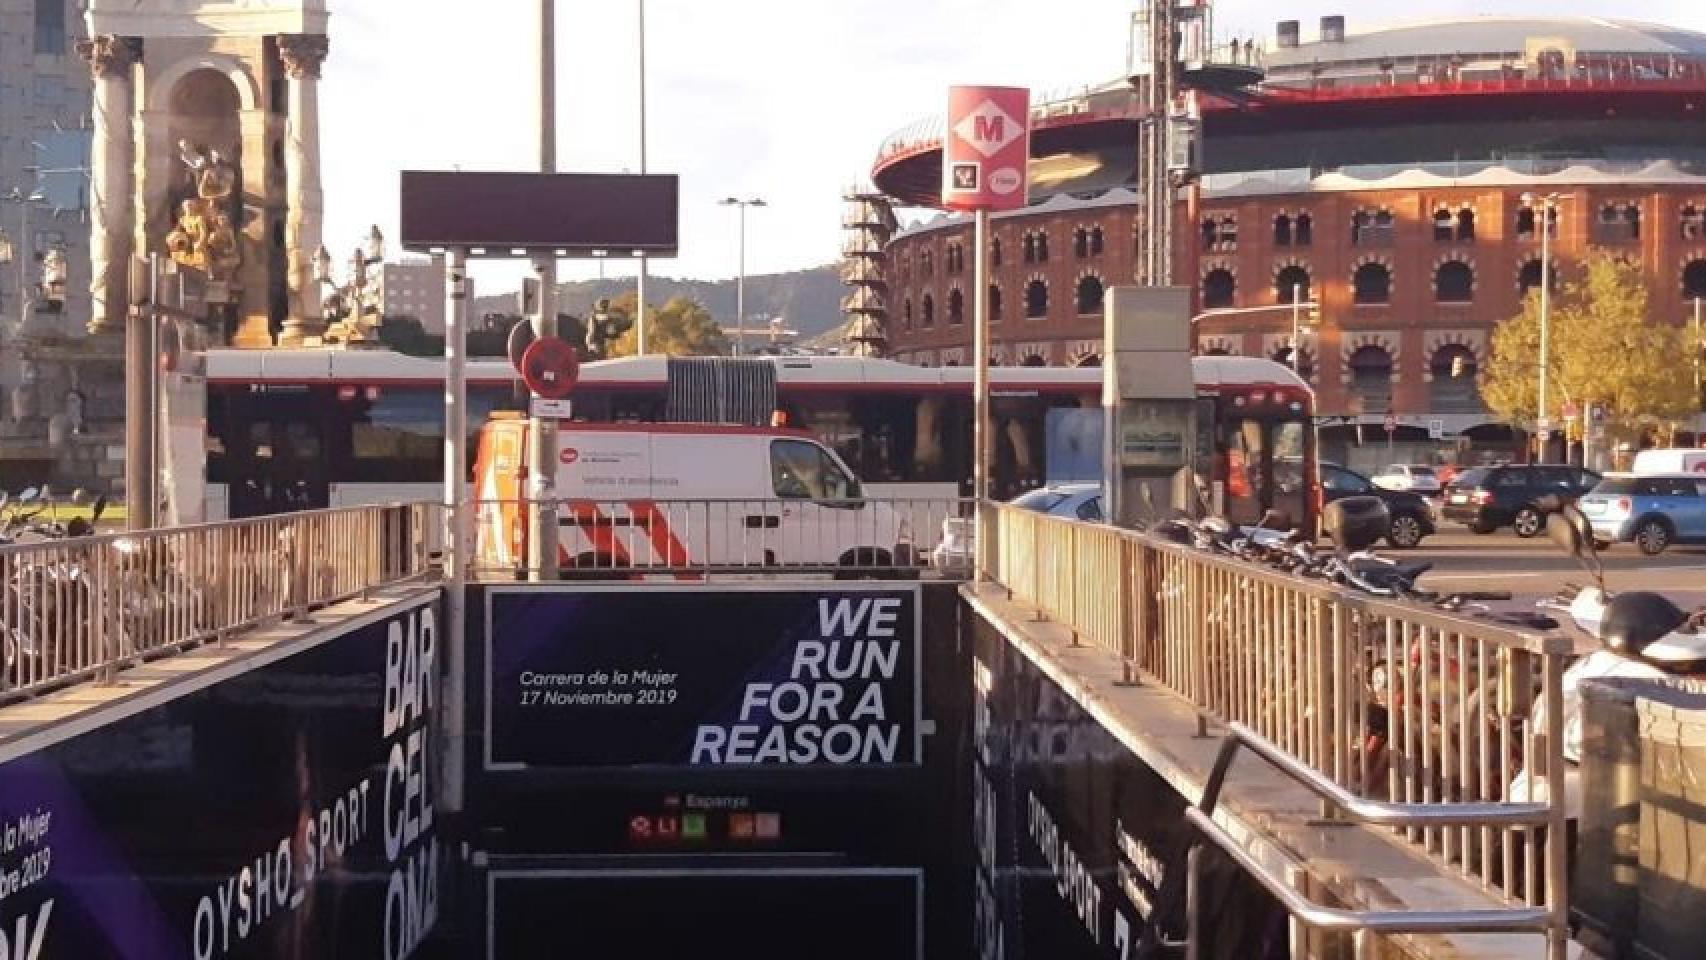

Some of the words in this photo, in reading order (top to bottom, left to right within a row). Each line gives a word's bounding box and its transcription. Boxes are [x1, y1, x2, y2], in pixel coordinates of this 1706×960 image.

[975, 115, 1003, 141] M
[818, 597, 901, 637] WE
[384, 607, 434, 738] BAR
[519, 671, 583, 686] Carrera
[587, 671, 608, 686] de
[612, 671, 629, 686] la
[632, 670, 678, 689] Mujer
[791, 640, 901, 679] RUN
[519, 691, 541, 705] 17
[544, 691, 633, 705] Noviembre
[636, 690, 678, 705] 2019
[739, 682, 842, 722] FOR
[849, 683, 886, 721] A
[690, 724, 901, 764] REASON
[384, 726, 433, 862] CEL
